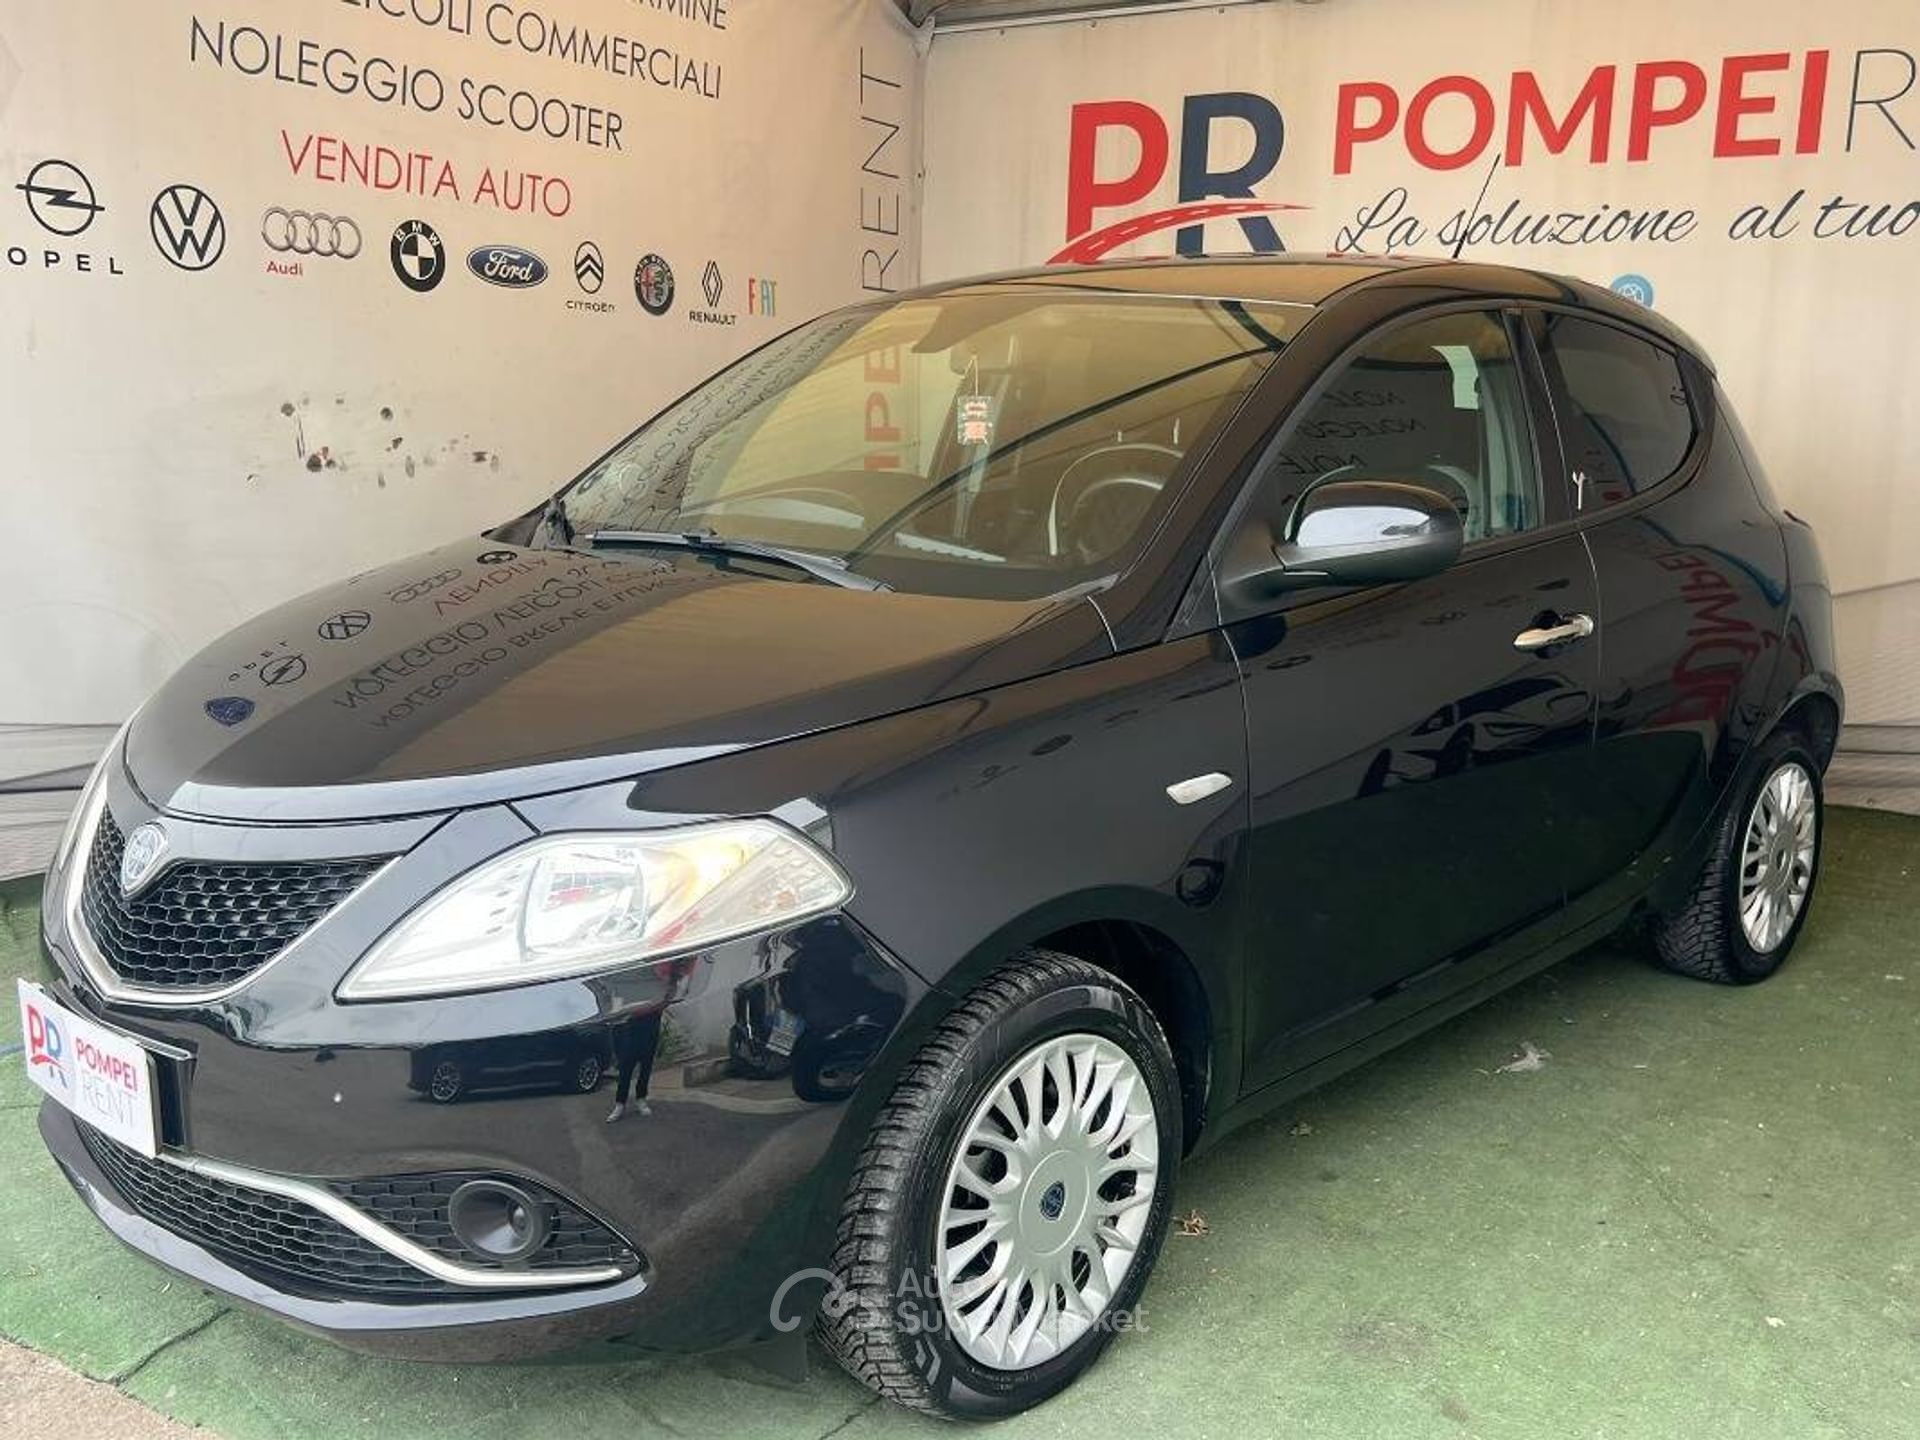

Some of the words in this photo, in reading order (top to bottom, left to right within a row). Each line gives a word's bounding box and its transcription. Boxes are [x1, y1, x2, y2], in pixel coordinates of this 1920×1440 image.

[189, 15, 445, 112] NOLEGGIO
[458, 77, 623, 151] SCOOTER
[485, 3, 722, 99] COMMERCIALI
[1333, 49, 1829, 175] POMPEI
[281, 129, 460, 201] VENDITA
[473, 166, 571, 218] AUTO
[861, 46, 902, 294] RENT
[1066, 91, 1287, 257] PR
[1334, 186, 1428, 253] La
[1436, 198, 1699, 247] soluzione
[1728, 189, 1806, 241] al
[1812, 195, 1920, 239] tuo
[7, 247, 125, 275] OPEL
[266, 260, 304, 277] Audi
[484, 250, 533, 281] Ford
[688, 311, 737, 326] RENAULT
[75, 1037, 138, 1092] POMPEI
